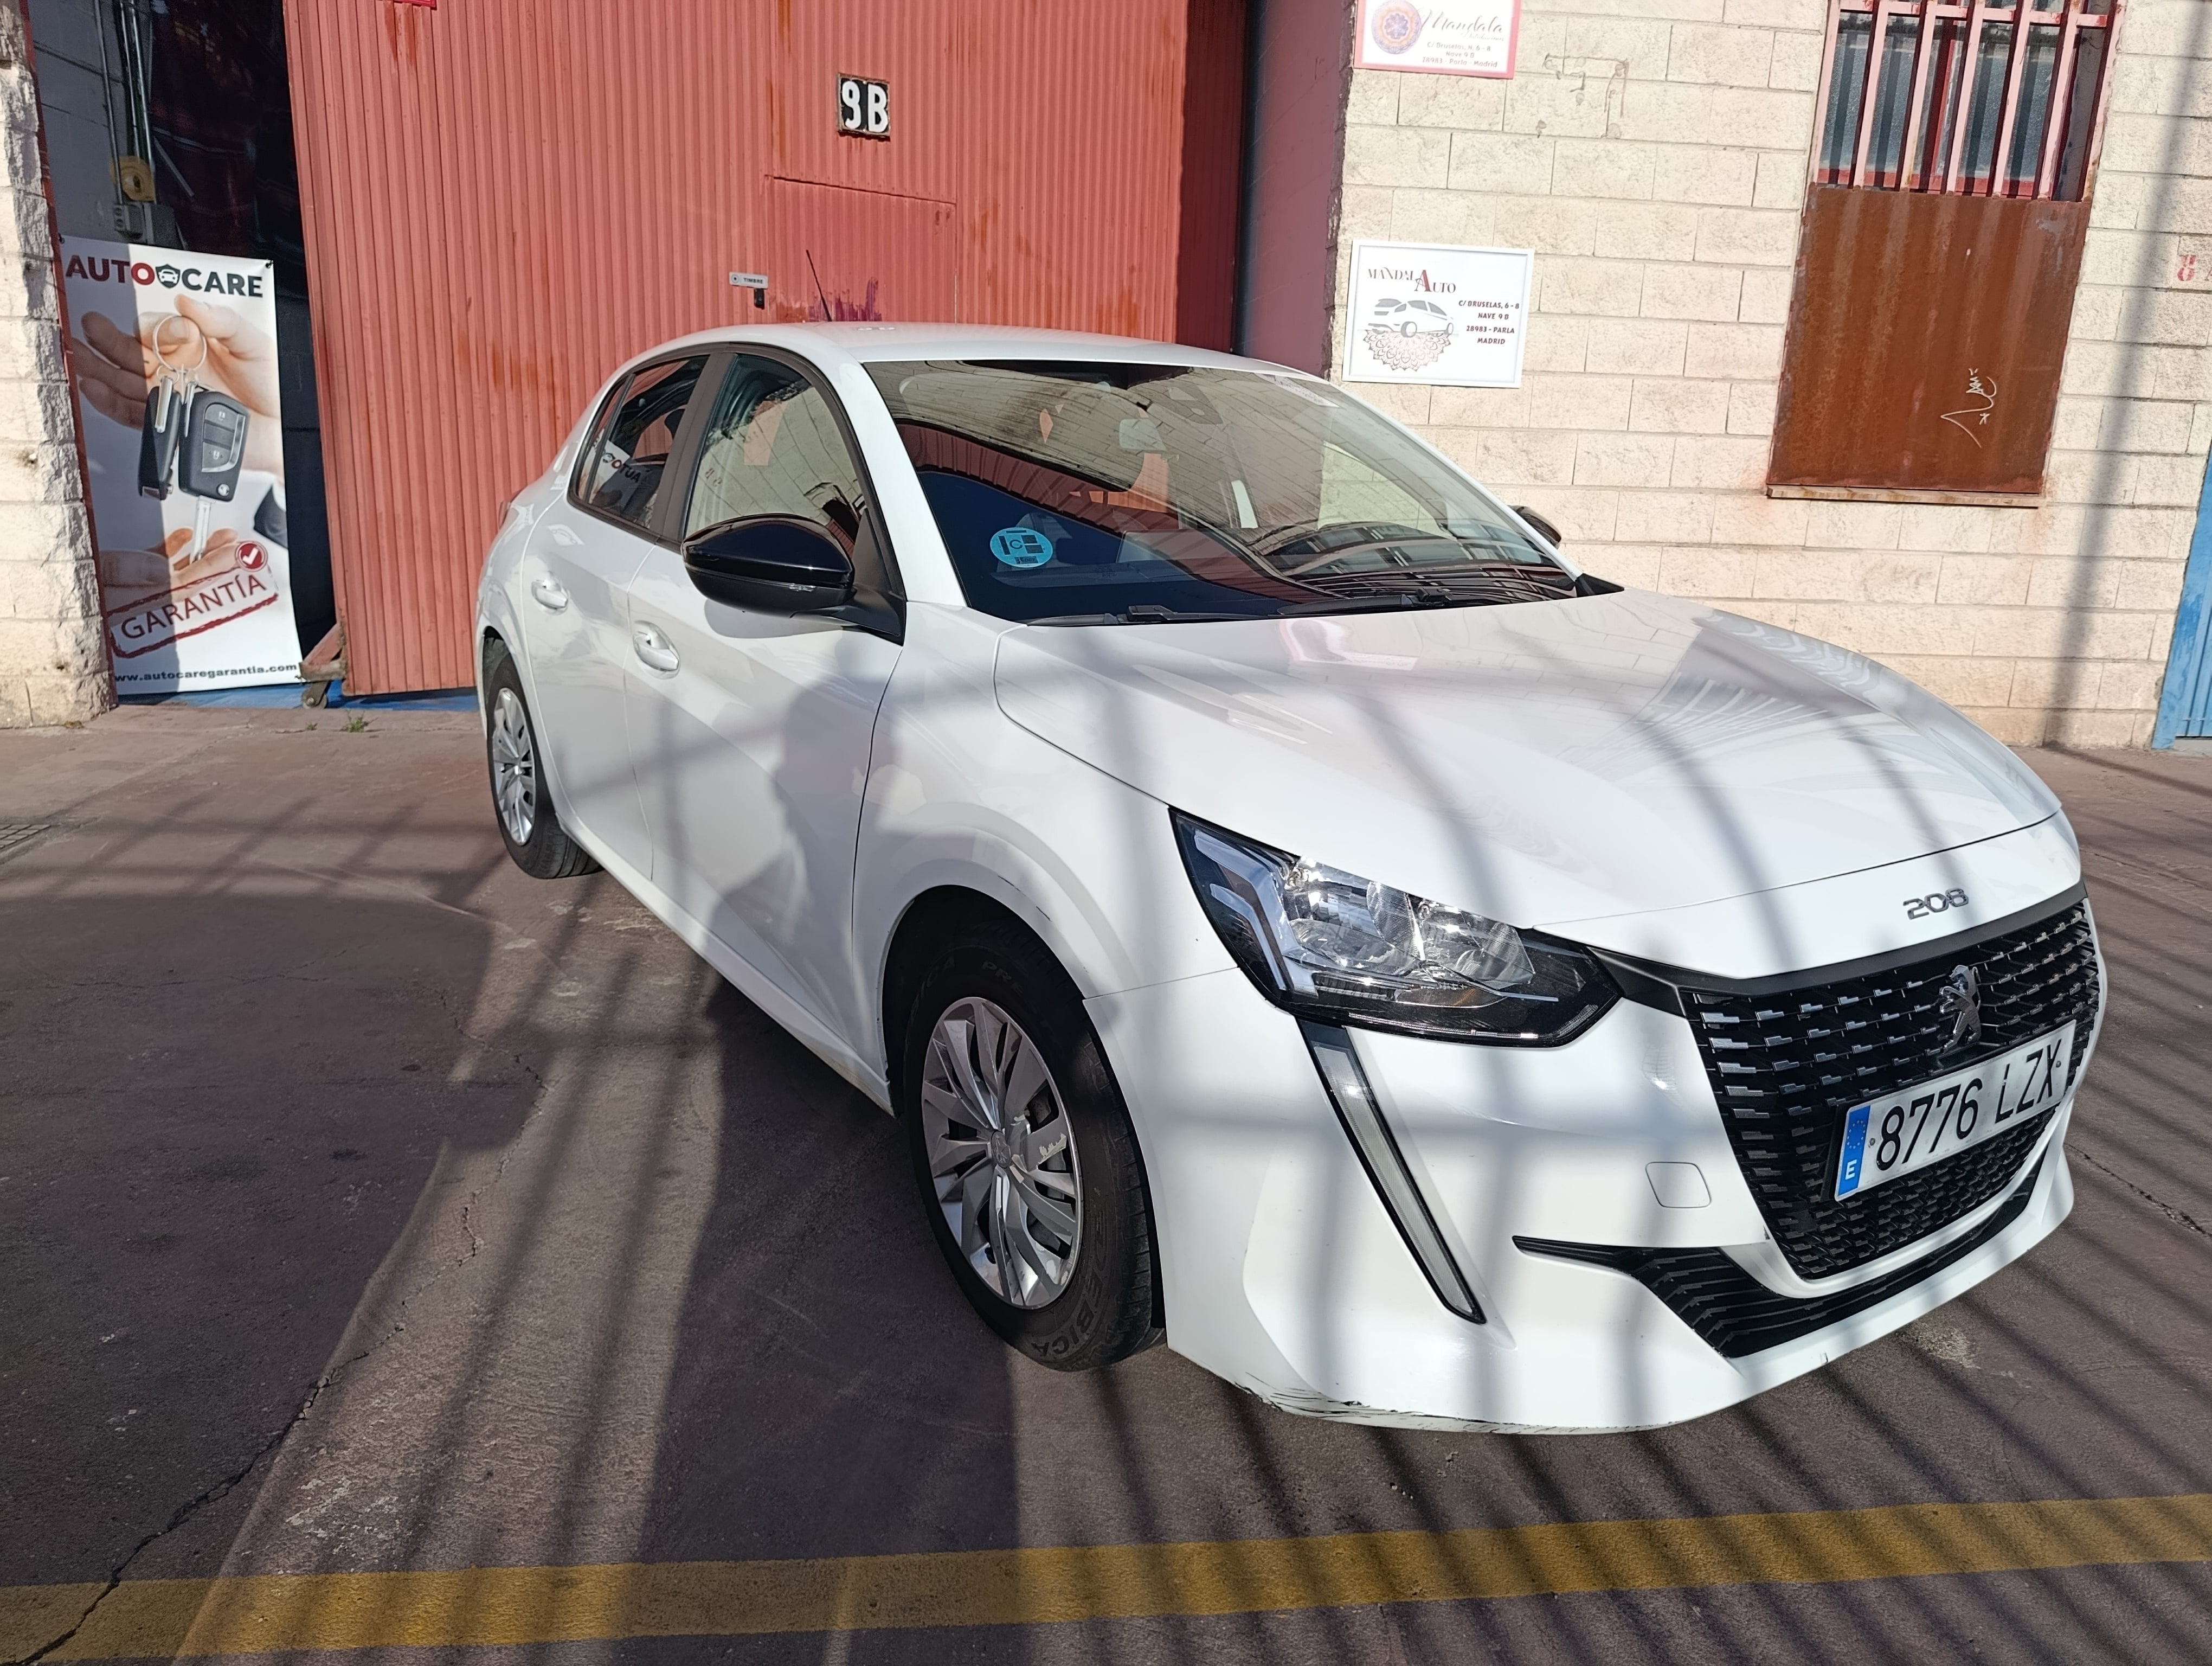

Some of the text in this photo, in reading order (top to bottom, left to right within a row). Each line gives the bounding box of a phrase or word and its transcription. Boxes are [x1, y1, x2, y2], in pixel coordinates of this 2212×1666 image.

[1420, 9, 1503, 33] Mandala
[181, 268, 263, 298] CARE
[1468, 300, 1503, 310] BRUSELAS,
[121, 574, 267, 639] GARANTÍA
[1903, 888, 1969, 920] 208
[1876, 1038, 2062, 1171] 8776 LZX
[1844, 1159, 1858, 1181] E
